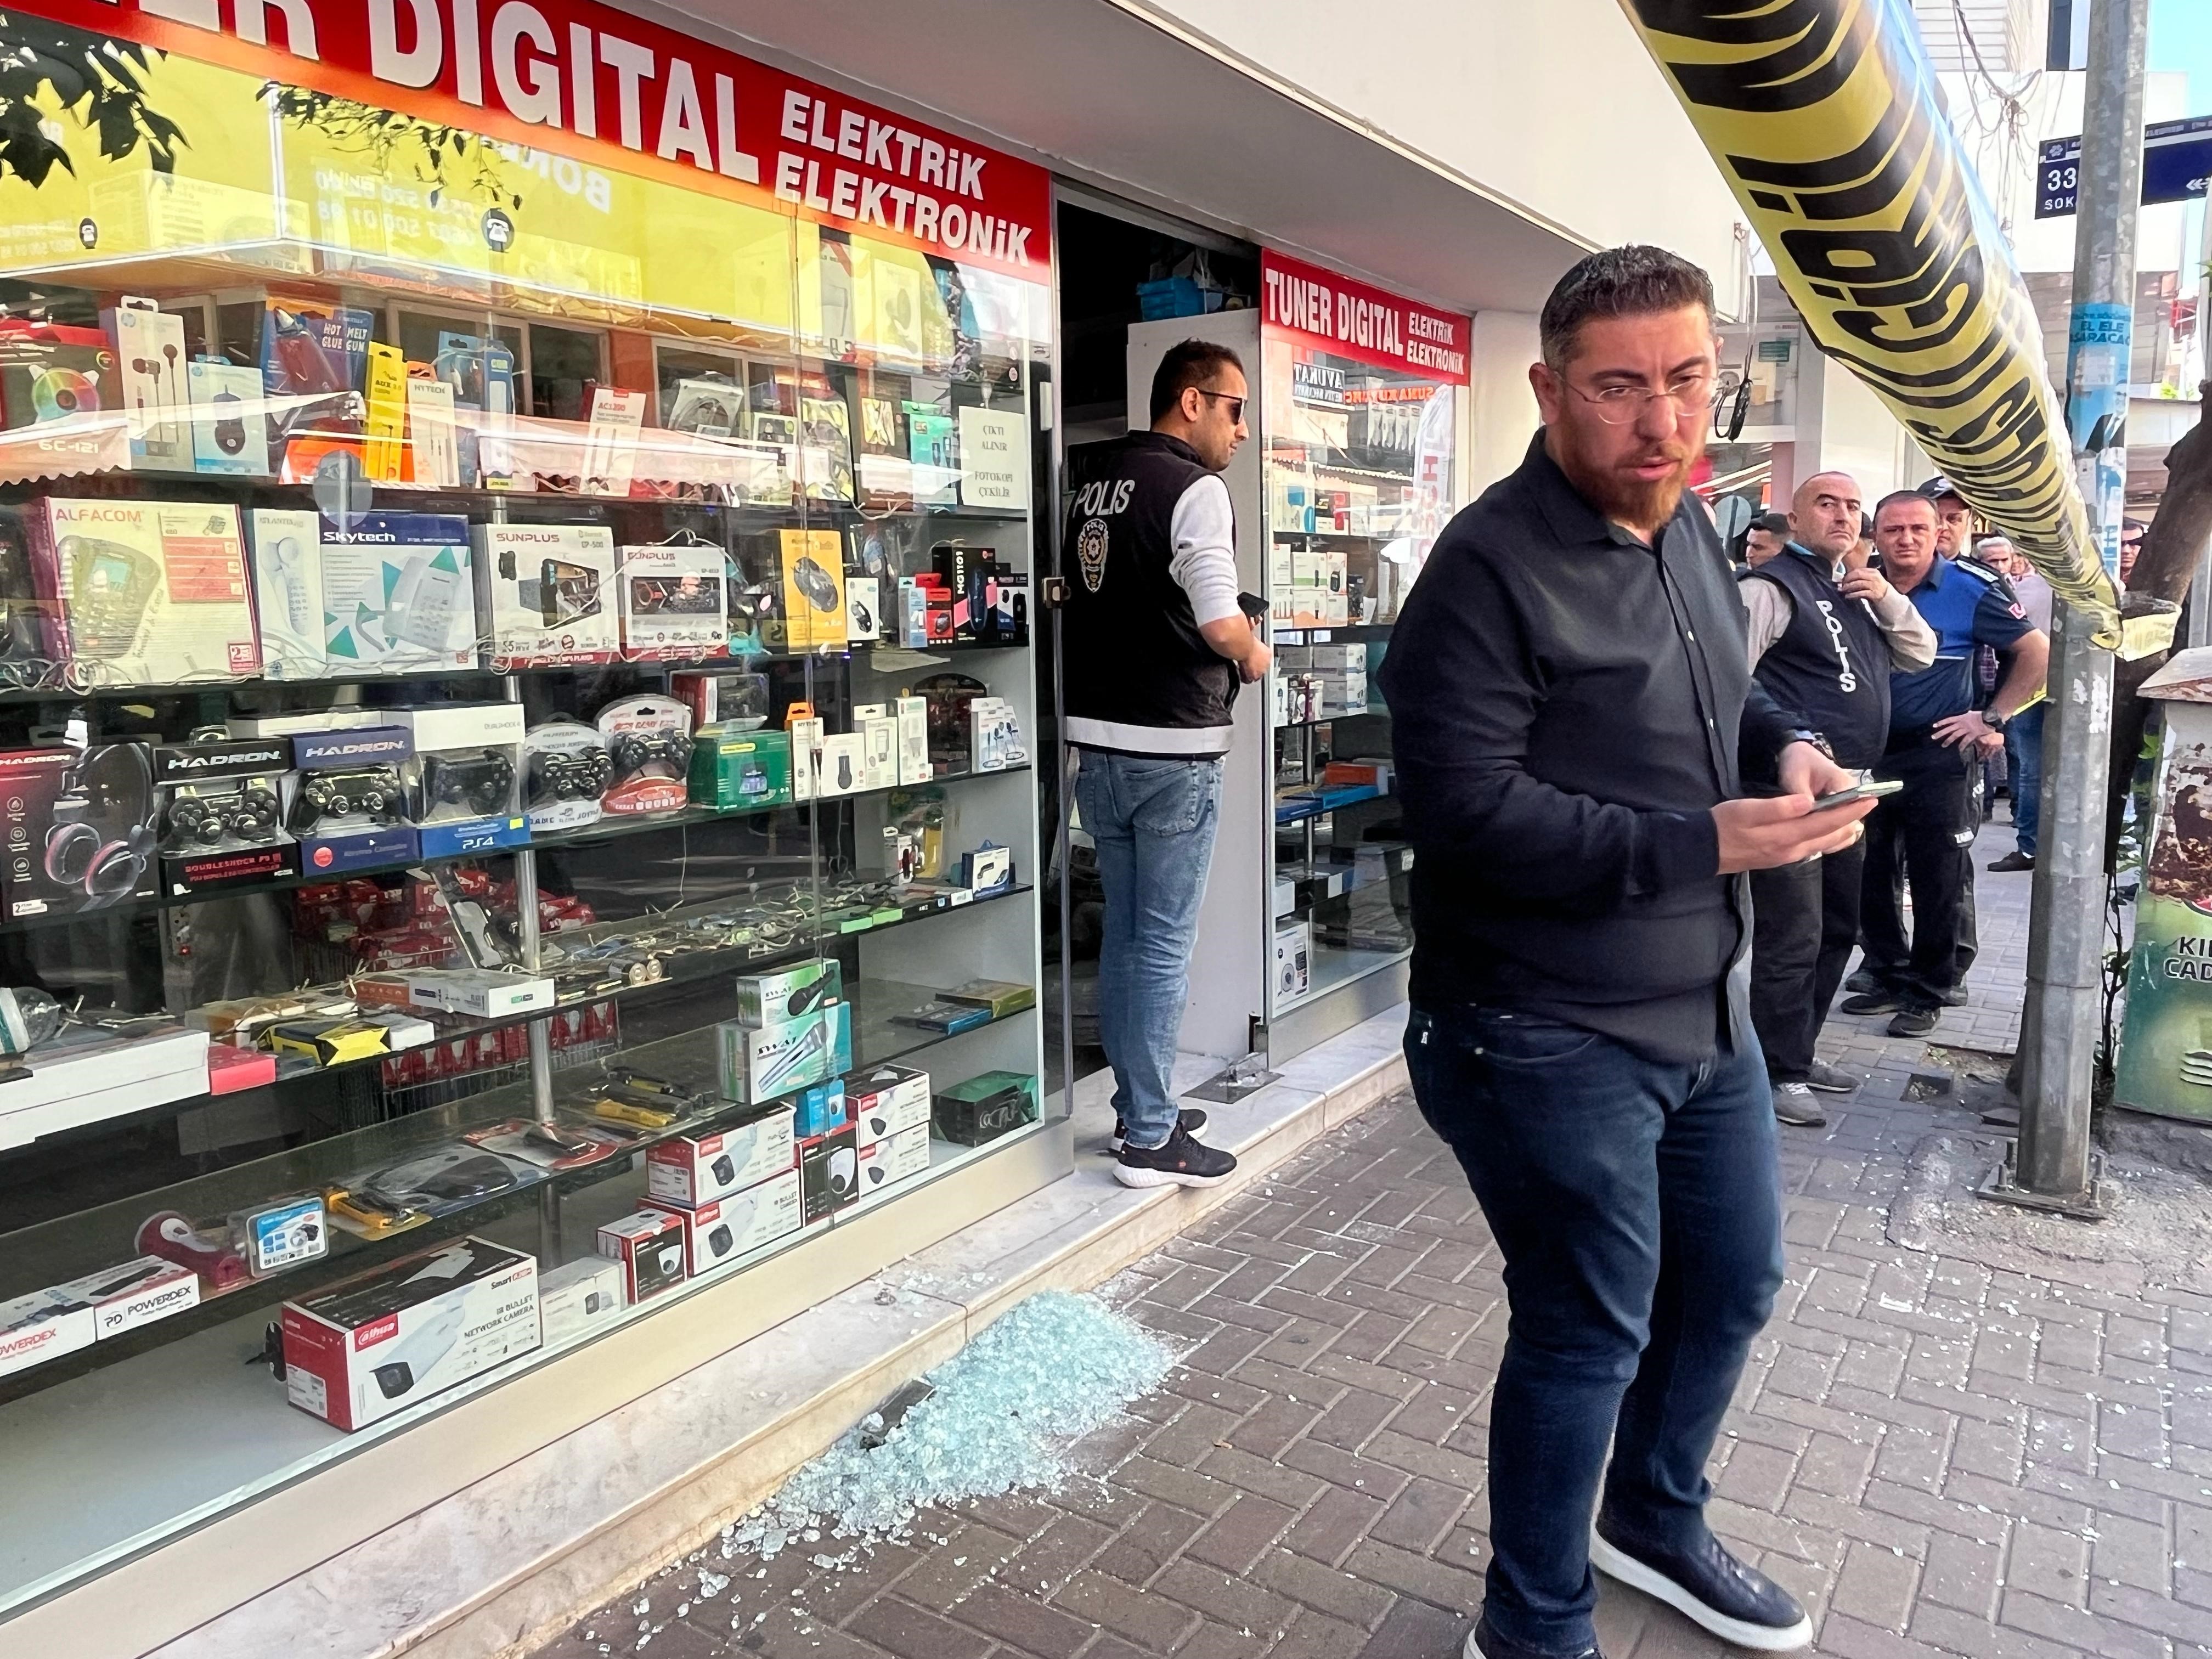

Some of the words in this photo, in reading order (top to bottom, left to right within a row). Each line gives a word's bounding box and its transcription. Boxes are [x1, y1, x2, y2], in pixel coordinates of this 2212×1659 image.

[368, 0, 759, 184] DIGITAL
[1265, 268, 1332, 337] TUNER
[1338, 292, 1403, 356] DIGITAL
[324, 323, 341, 335] HOT
[347, 327, 368, 340] MELT
[322, 336, 342, 349] GLUE
[346, 340, 365, 352] GUN
[1073, 479, 1135, 518] POLIS
[56, 509, 142, 522] ALFACOM
[323, 532, 396, 544] Skytech
[496, 533, 560, 543] SUNPLUS
[1816, 600, 1856, 692] POLIS
[305, 741, 405, 758] HADRON
[168, 751, 281, 769] HADRON
[462, 836, 494, 849] PS4
[128, 1285, 191, 1316] POWERDEX
[504, 1305, 534, 1322] CAMERA
